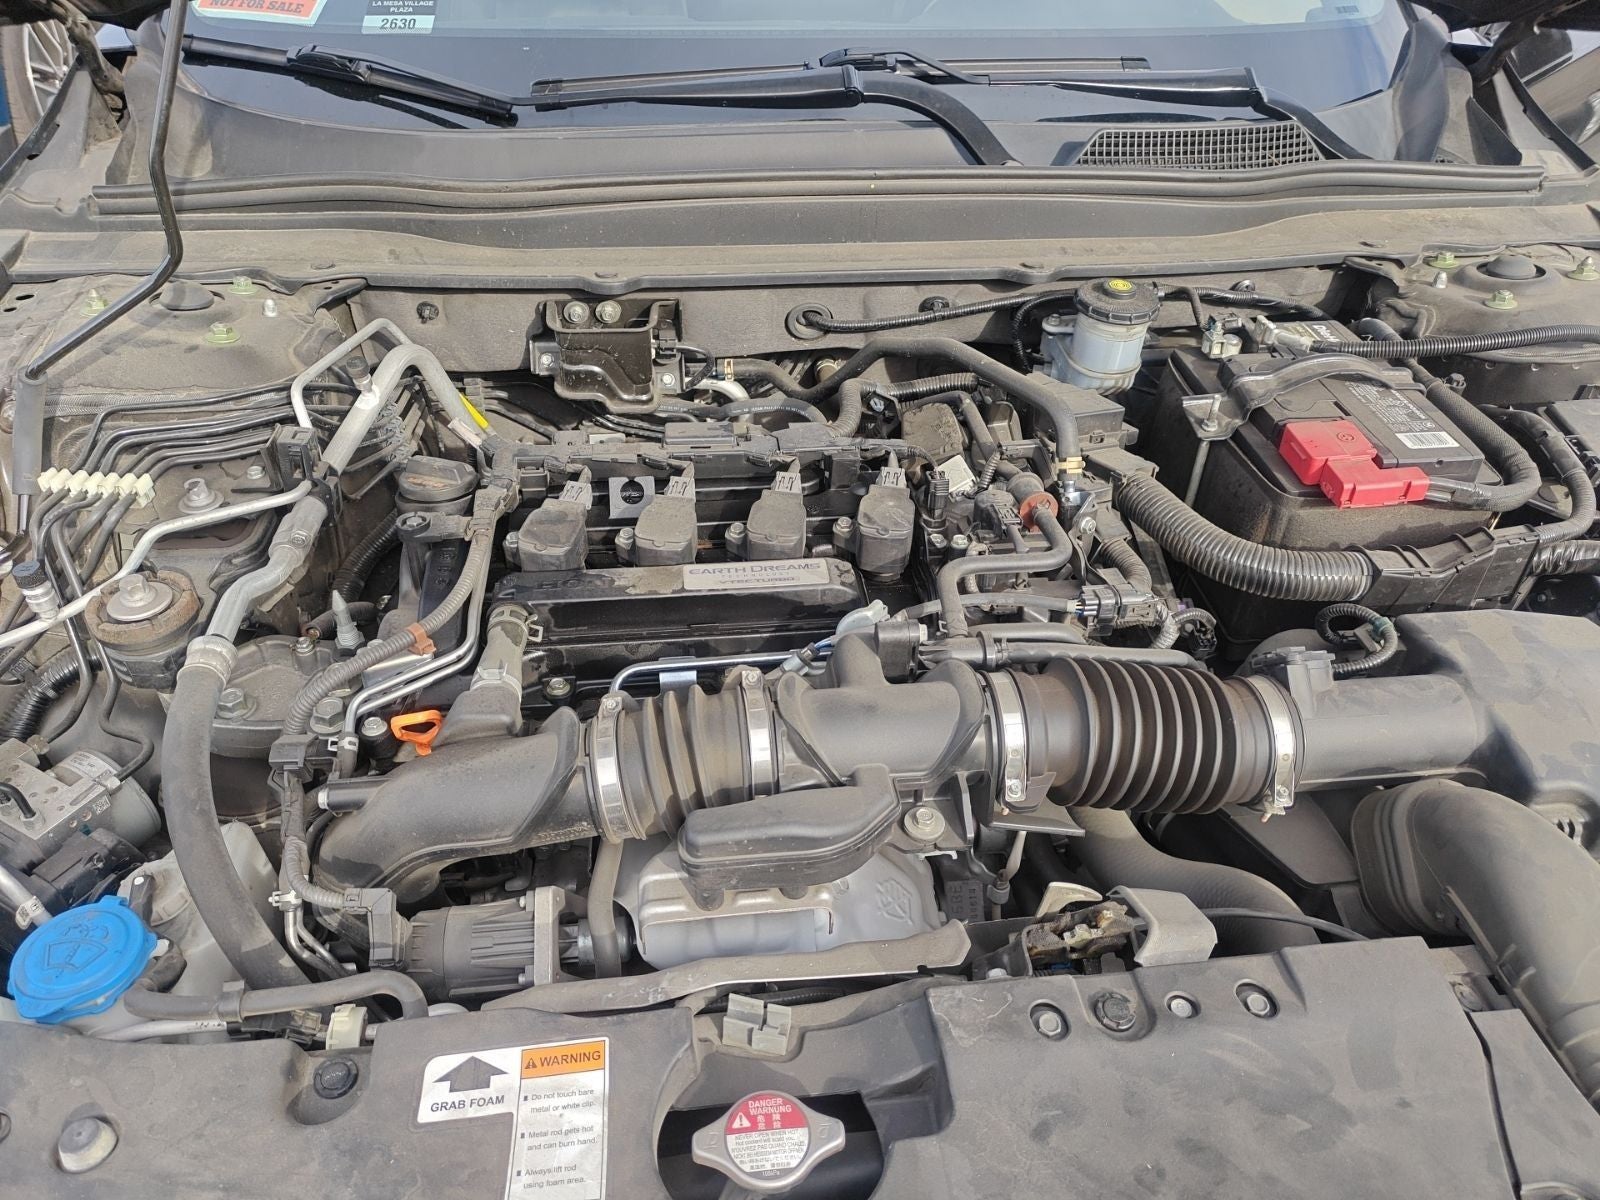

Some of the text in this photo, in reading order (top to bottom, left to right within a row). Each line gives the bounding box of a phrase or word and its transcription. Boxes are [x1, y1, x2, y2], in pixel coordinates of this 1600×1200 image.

[239, 0, 264, 9] FOR
[266, 1, 305, 14] SALE
[380, 18, 417, 30] 2630
[689, 563, 821, 575] EARTH DREAMS
[540, 1051, 601, 1067] WARNING
[531, 1093, 542, 1101] Do
[557, 1088, 577, 1098] touch
[578, 1087, 594, 1096] bare
[430, 1095, 505, 1113] GRAB FOAM
[530, 1104, 551, 1114] metal
[561, 1101, 581, 1110] white
[748, 1098, 784, 1108] DANGER
[749, 1105, 792, 1115] WARNUNG
[528, 1129, 549, 1139] Metal
[550, 1128, 563, 1136] rod
[564, 1127, 580, 1136] gets
[527, 1143, 542, 1151] and
[558, 1140, 575, 1148] burn
[524, 1164, 577, 1177] Always lift rod
[523, 1181, 544, 1190] using
[546, 1179, 565, 1187] foam
